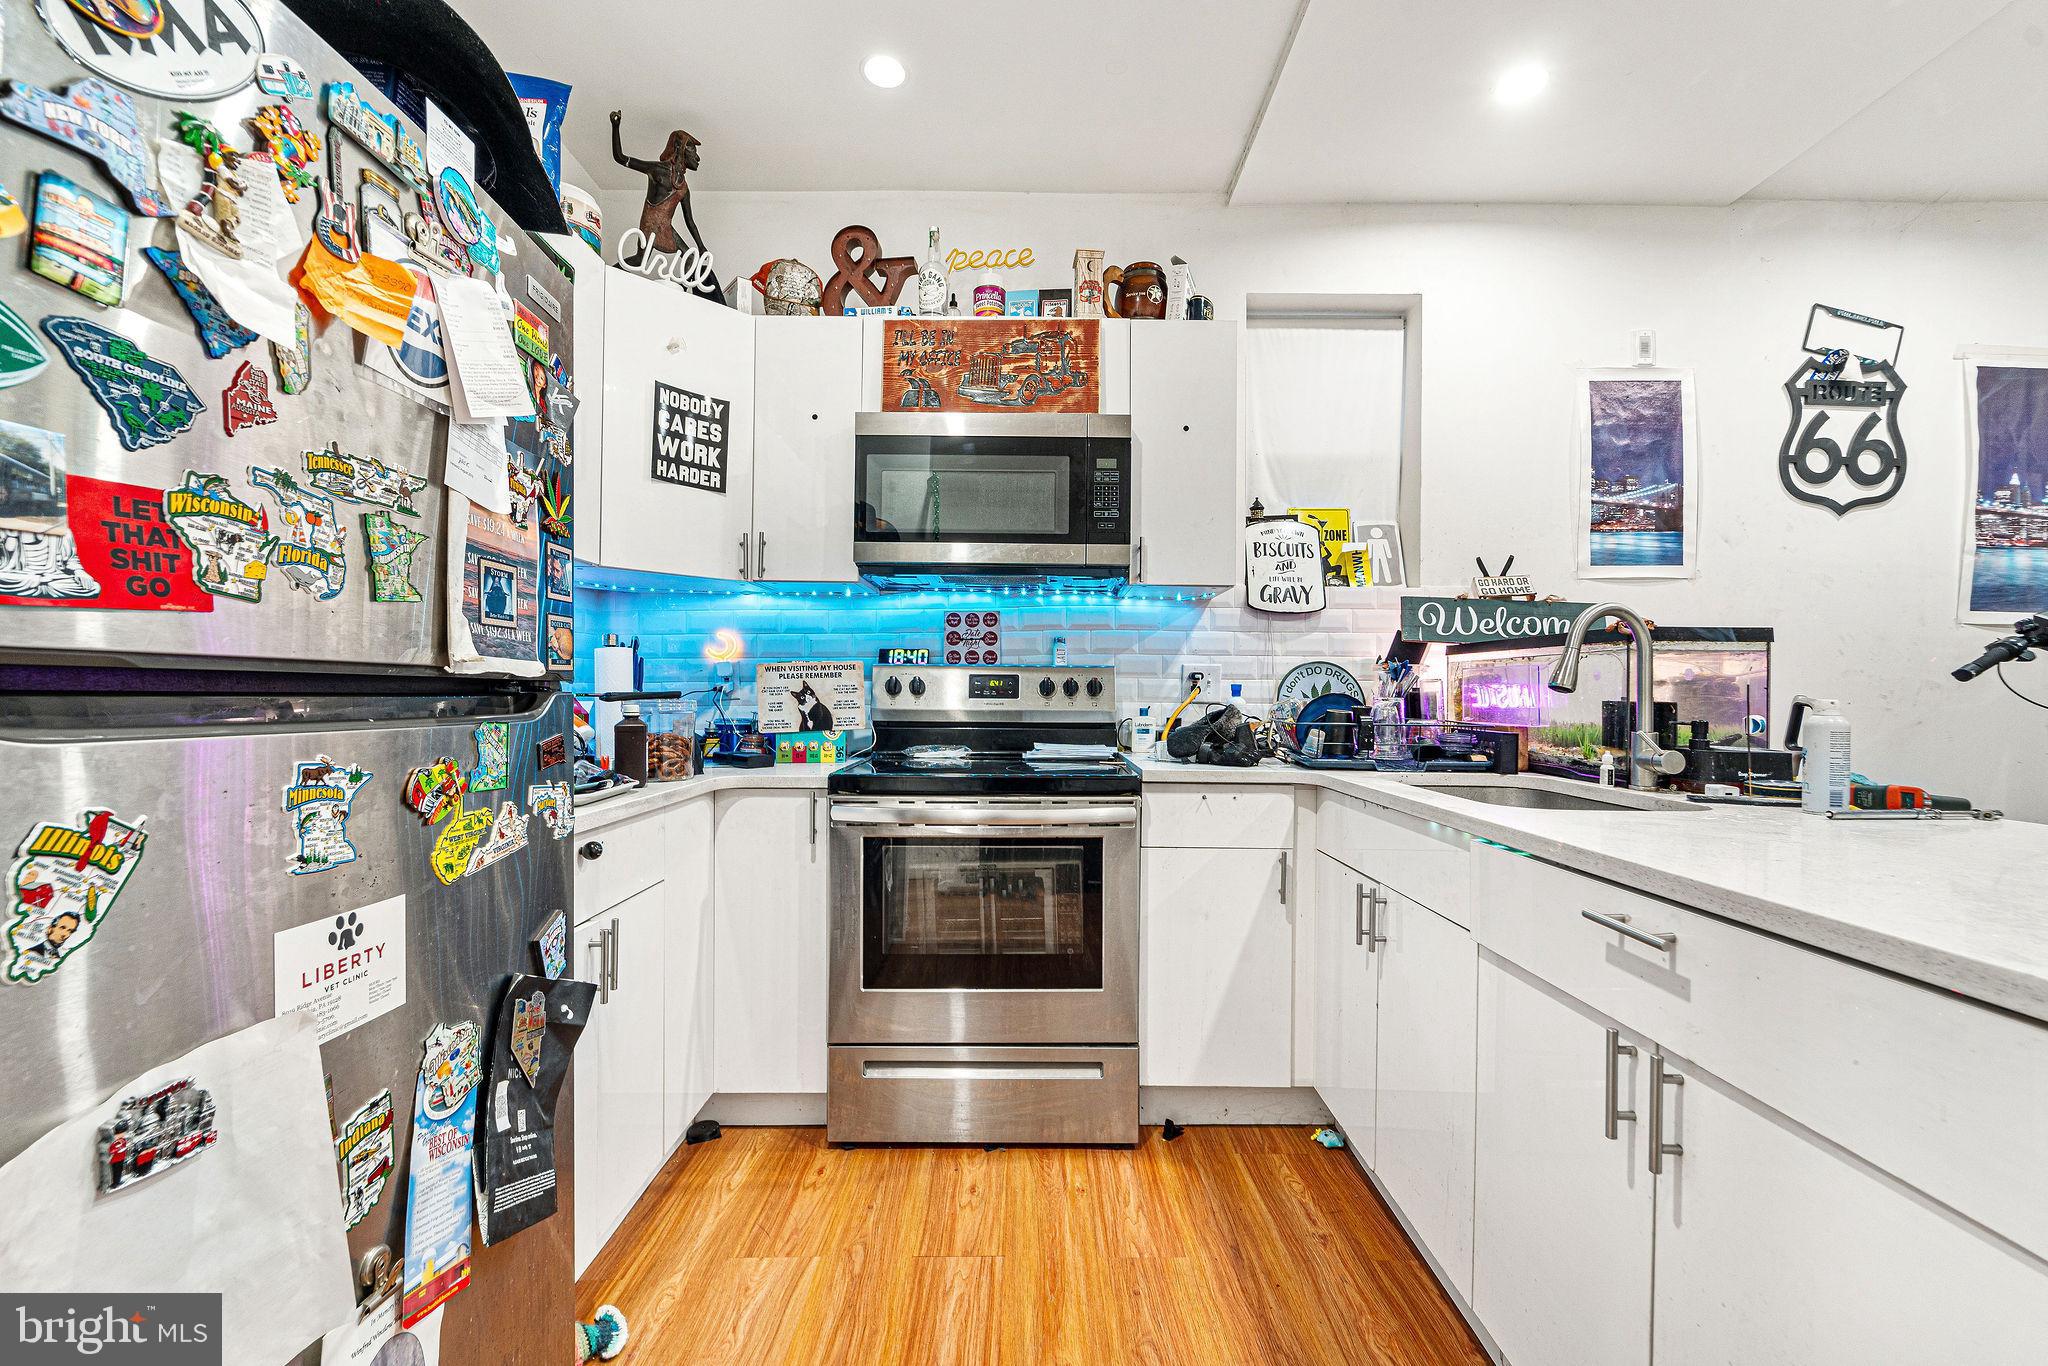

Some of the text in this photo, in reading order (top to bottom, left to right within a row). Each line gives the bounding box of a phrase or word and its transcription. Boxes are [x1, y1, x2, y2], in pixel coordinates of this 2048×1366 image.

[618, 228, 715, 293] Chill
[945, 247, 1036, 274] peace
[861, 307, 893, 316] WILLIAM'S
[920, 329, 937, 347] BE
[73, 346, 122, 370] SOUTH
[122, 362, 189, 393] CAROLINA
[659, 387, 724, 419] NOBODY
[1812, 383, 1883, 403] ROUTE
[236, 397, 272, 415] MAINE
[658, 408, 723, 444] CARES
[656, 433, 722, 469] WORK
[1796, 409, 1895, 487] 66
[306, 452, 355, 477] Tennessee
[656, 459, 721, 489] HARDER
[112, 495, 166, 520] LET
[170, 492, 254, 524] Wisconsin
[101, 520, 180, 550] THAT
[1323, 529, 1347, 542] ZONE
[110, 547, 181, 574] SHIT
[278, 544, 328, 572] Florida
[1253, 540, 1315, 559] BISCUITS
[467, 551, 528, 580] SAV EEK
[490, 567, 509, 579] STORM
[1274, 560, 1297, 572] AND
[126, 575, 171, 598] GO
[1259, 584, 1314, 605] GRAVY
[1477, 577, 1530, 587] GO HARD OR
[1480, 586, 1533, 595] GO HOME
[517, 597, 528, 611] EEK
[470, 621, 486, 636] SAVE
[516, 628, 532, 643] WEEK
[1417, 602, 1571, 638] Welcom
[764, 665, 786, 673] WHEN
[787, 664, 819, 672] VISITING
[833, 663, 857, 671] HOUSE
[888, 648, 929, 664] 18:40
[1286, 671, 1307, 694] don't
[1305, 665, 1322, 677] DO
[1325, 667, 1359, 698] DRUGS
[288, 787, 344, 808] Minnesota
[29, 826, 122, 871] Illinois
[301, 942, 386, 989] LIBERTY
[324, 970, 369, 993] VET CLINIC
[339, 1112, 386, 1161] Indiana
[428, 1127, 459, 1151] BEST OF
[428, 1133, 471, 1163] WISCONSIN
